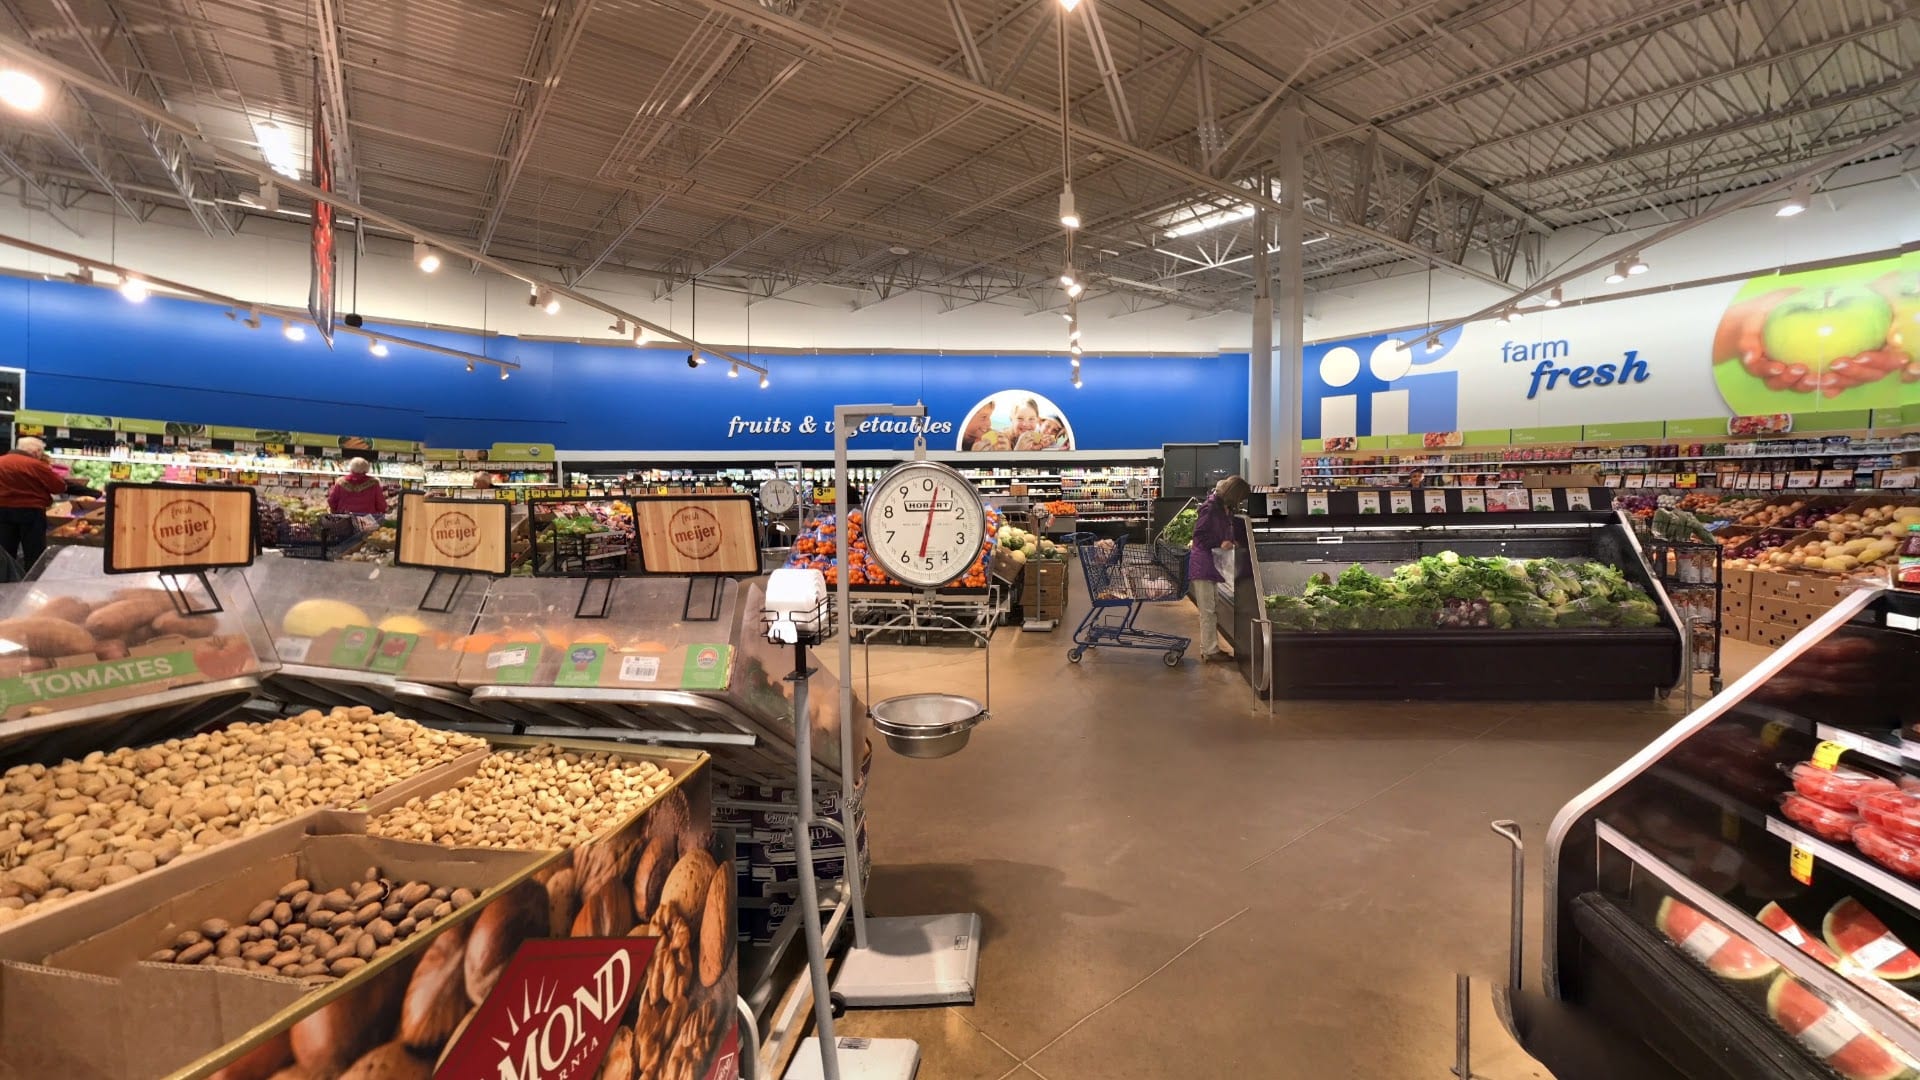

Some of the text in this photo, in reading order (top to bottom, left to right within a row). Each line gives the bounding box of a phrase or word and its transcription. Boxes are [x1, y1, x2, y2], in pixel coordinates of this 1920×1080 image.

[1501, 339, 1568, 363] farm
[1527, 350, 1650, 399] fresh
[728, 415, 952, 438] fruits & vetaables
[160, 519, 209, 538] meijer
[436, 527, 477, 541] meijer
[675, 525, 716, 543] meijer
[23, 657, 174, 697] TOMATES
[480, 948, 631, 1080] MOND
